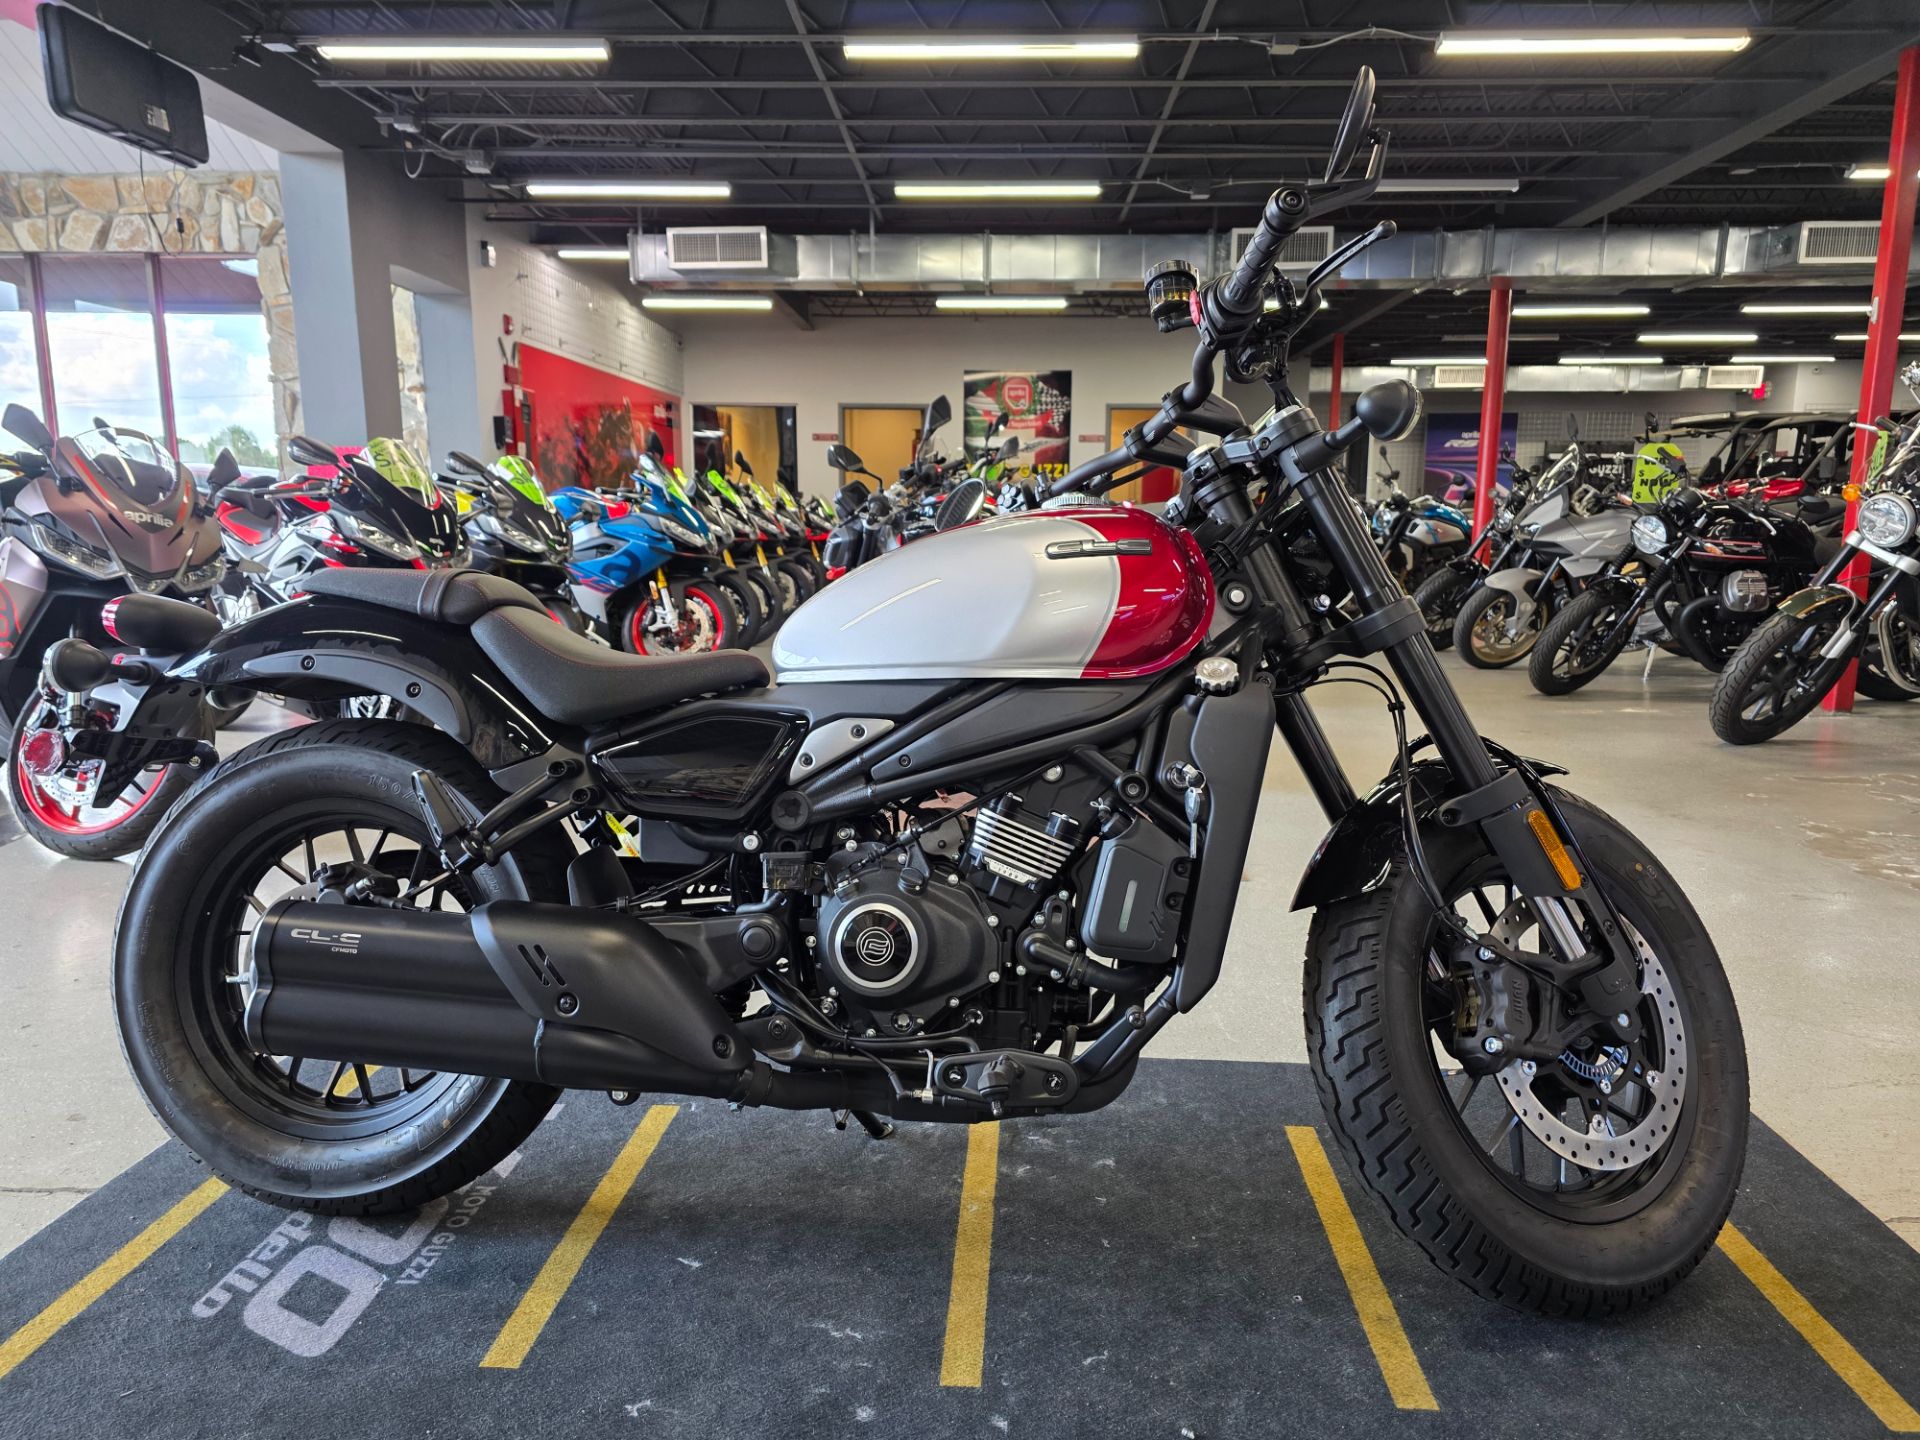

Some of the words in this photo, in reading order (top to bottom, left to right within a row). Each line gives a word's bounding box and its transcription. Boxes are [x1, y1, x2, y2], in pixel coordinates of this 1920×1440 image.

[123, 510, 174, 528] aprilia
[445, 1185, 498, 1228] MOTO
[394, 1232, 456, 1284] GUZZI
